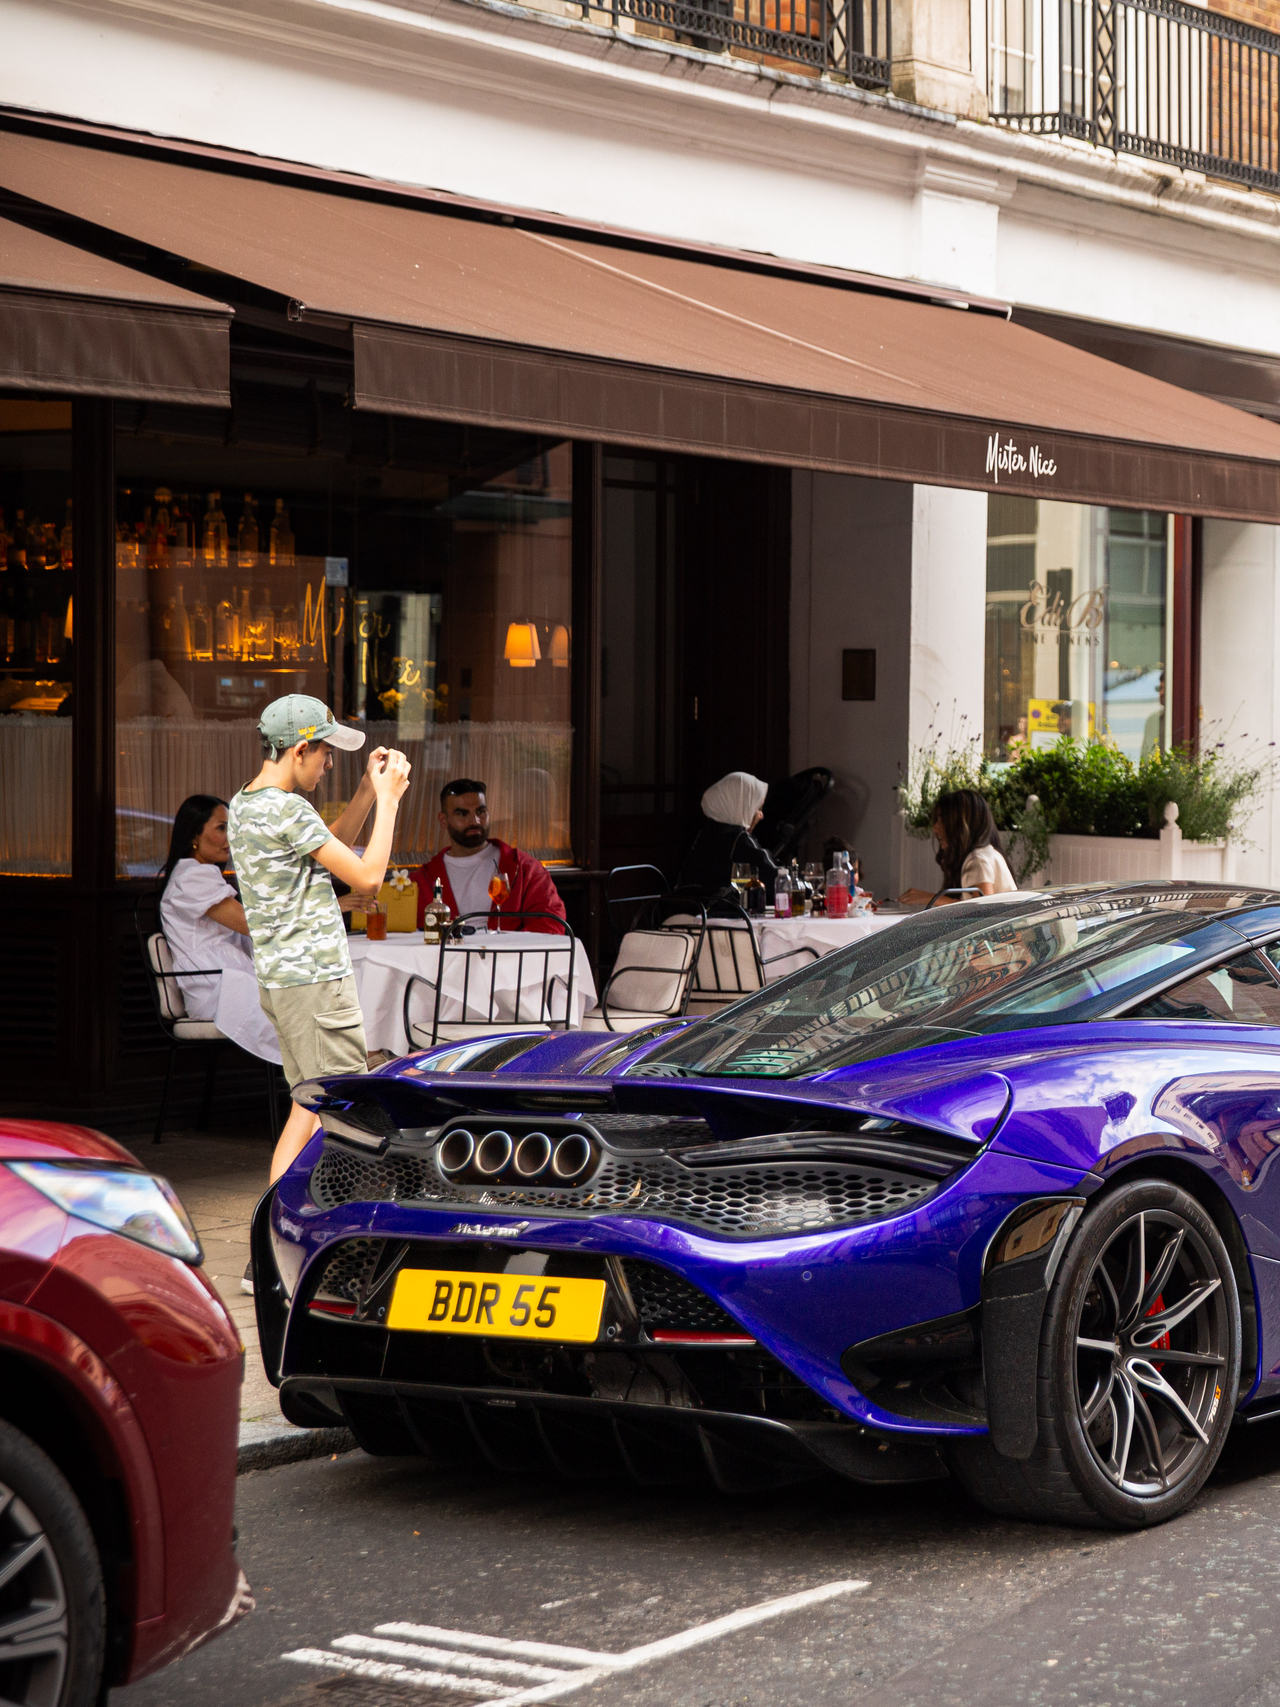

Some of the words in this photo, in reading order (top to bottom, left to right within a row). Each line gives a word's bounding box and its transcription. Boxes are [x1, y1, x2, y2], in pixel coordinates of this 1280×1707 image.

[985, 431, 1027, 484] Mister
[1029, 445, 1057, 478] Nice
[1020, 580, 1065, 628] Edi
[1067, 584, 1111, 629] B
[448, 1222, 520, 1238] McLaren
[427, 1279, 500, 1325] BDR
[509, 1284, 561, 1328] 55
[1208, 1384, 1222, 1424] 765LT
